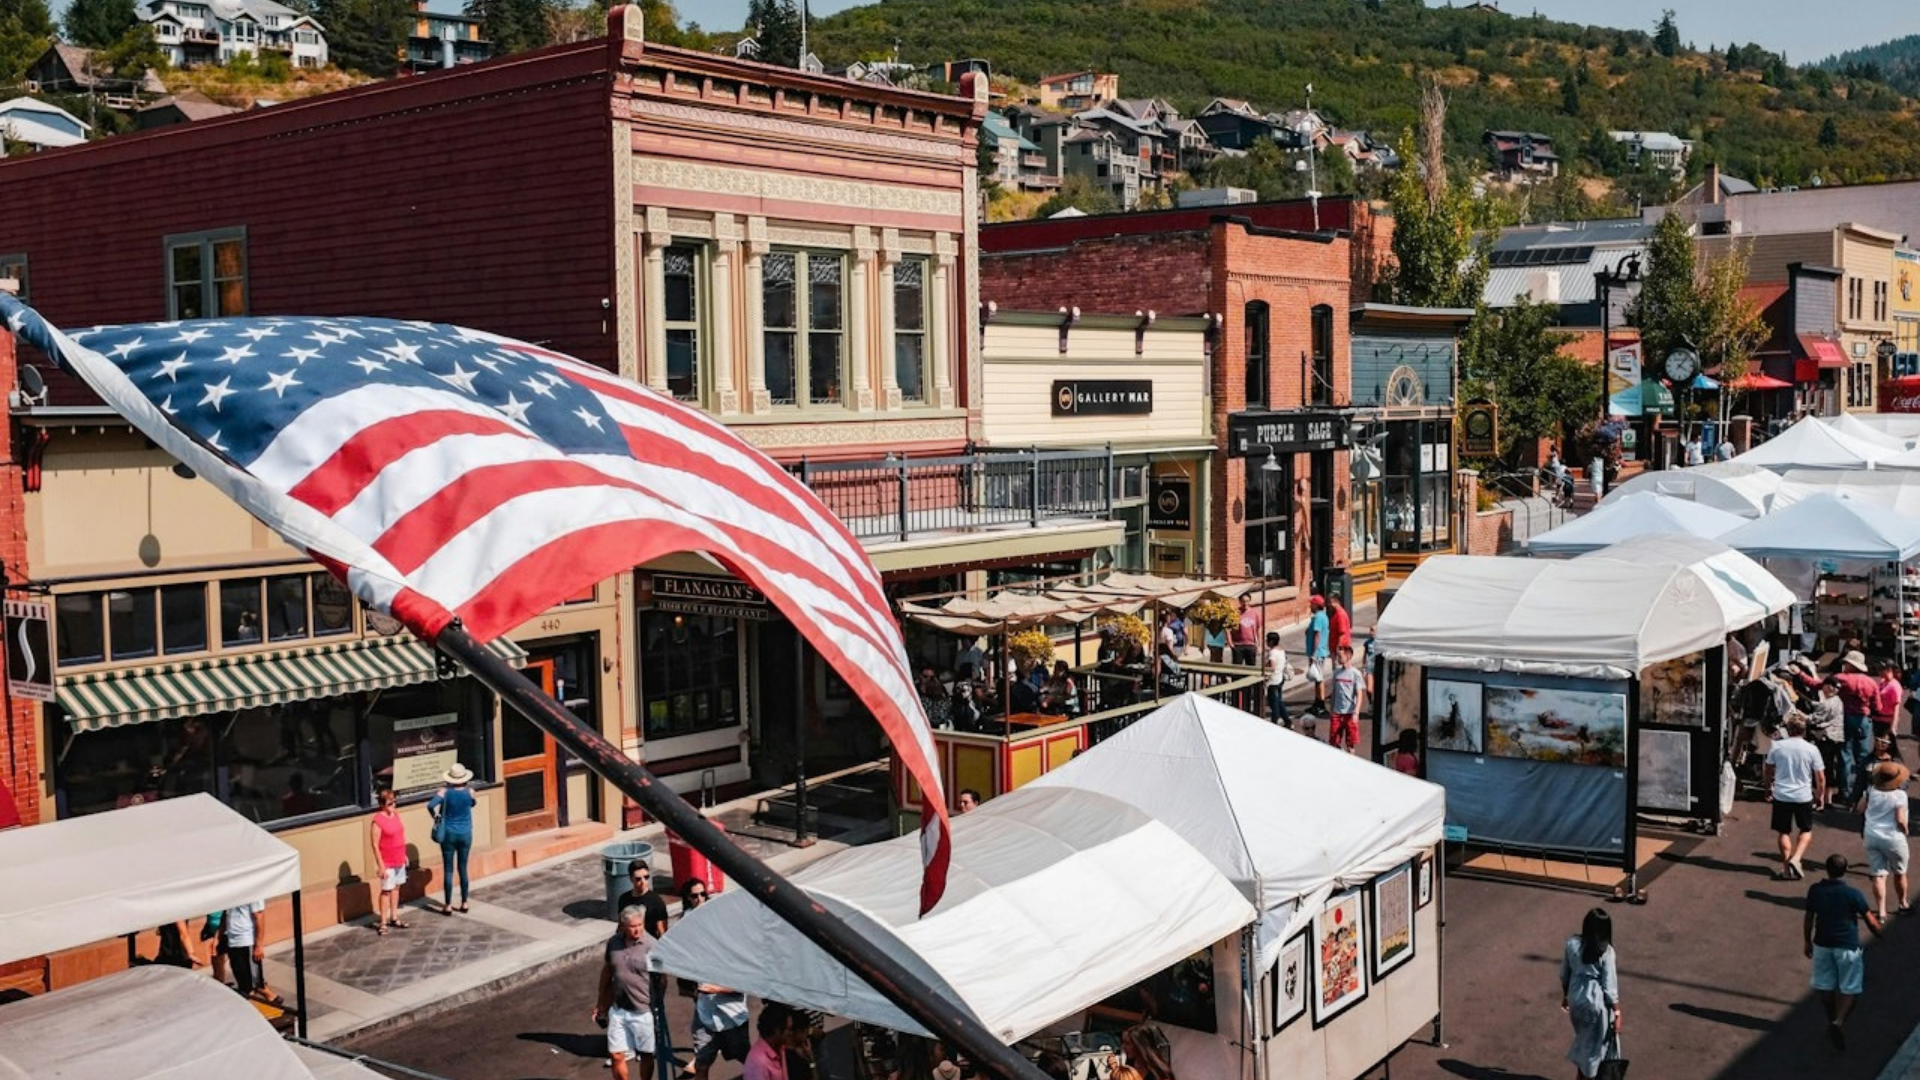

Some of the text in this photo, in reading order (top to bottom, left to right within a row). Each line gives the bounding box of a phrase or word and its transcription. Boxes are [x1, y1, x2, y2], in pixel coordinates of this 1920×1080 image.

[1078, 392, 1125, 403] GALLERY
[1128, 392, 1150, 403] MAR
[1256, 421, 1332, 443] PURPLE SAGE
[665, 579, 754, 599] FLANAGAN'S
[541, 619, 561, 631] 440
